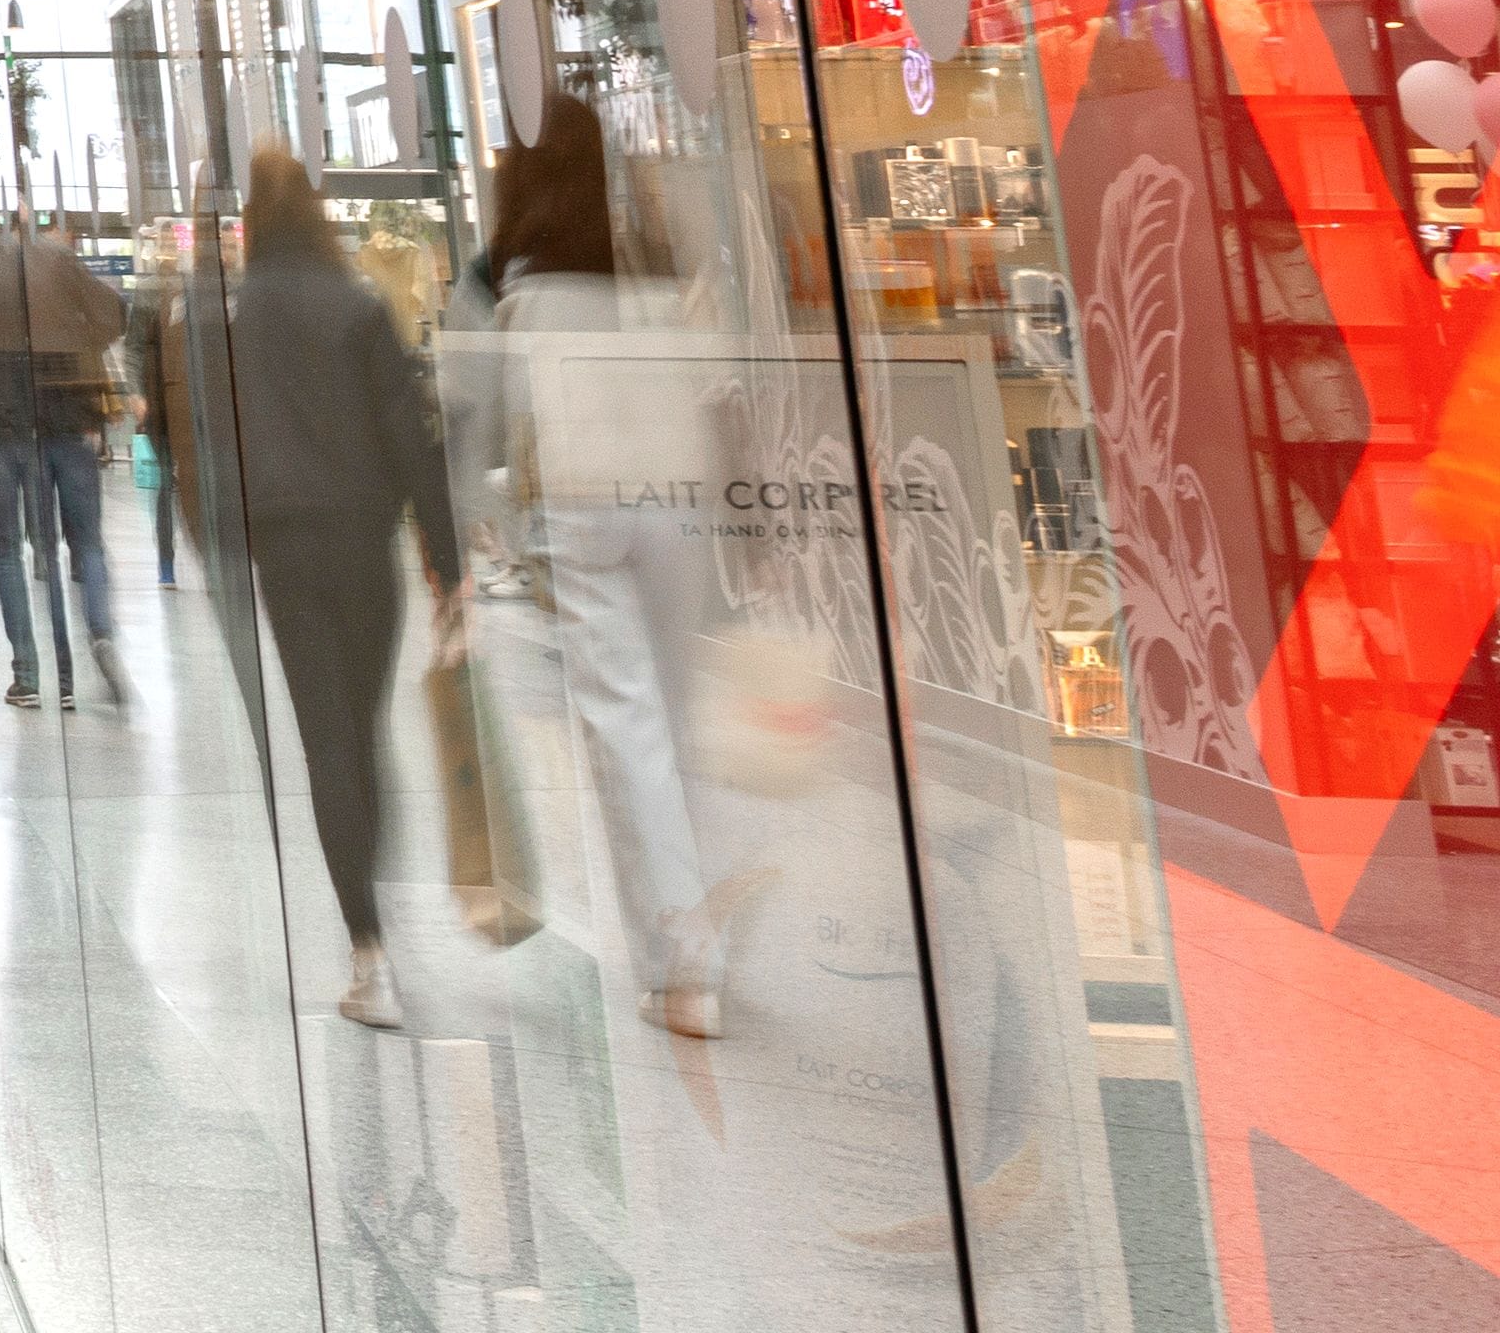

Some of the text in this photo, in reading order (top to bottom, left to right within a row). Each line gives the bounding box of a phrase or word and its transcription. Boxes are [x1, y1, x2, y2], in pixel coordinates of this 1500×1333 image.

[613, 479, 949, 512] LAIT CORPREL
[710, 523, 765, 538] HAND
